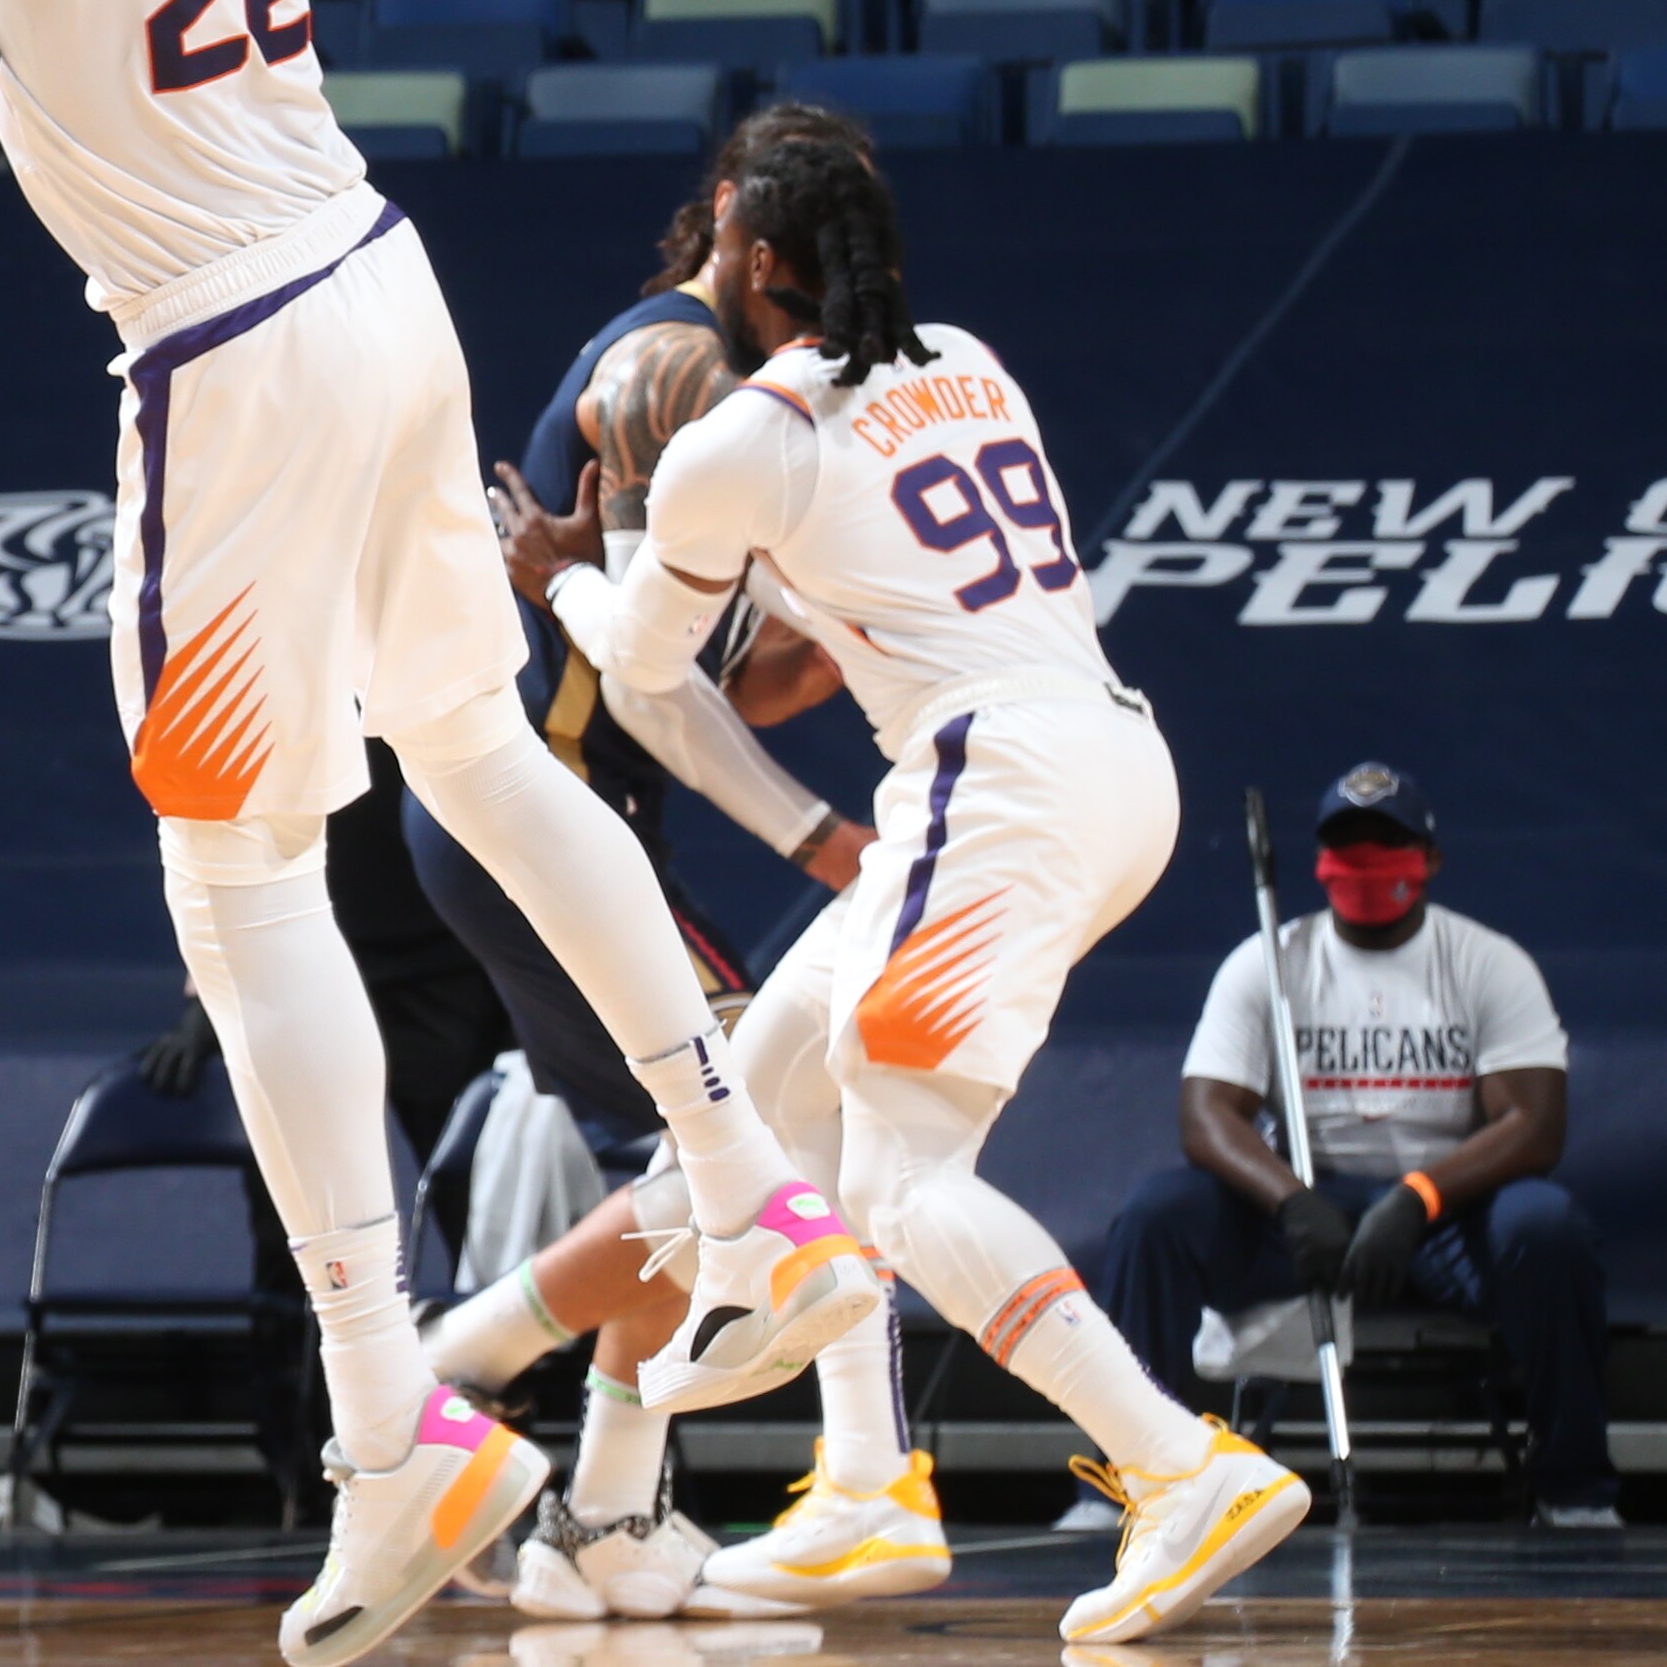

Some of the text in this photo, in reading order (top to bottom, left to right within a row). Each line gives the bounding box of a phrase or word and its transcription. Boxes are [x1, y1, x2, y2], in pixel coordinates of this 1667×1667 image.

[851, 374, 1013, 459] CROWDER
[889, 437, 1083, 615] 99
[1122, 476, 1577, 540] NEW
[1085, 536, 1667, 627] PELI
[1296, 1025, 1472, 1073] PELICANS
